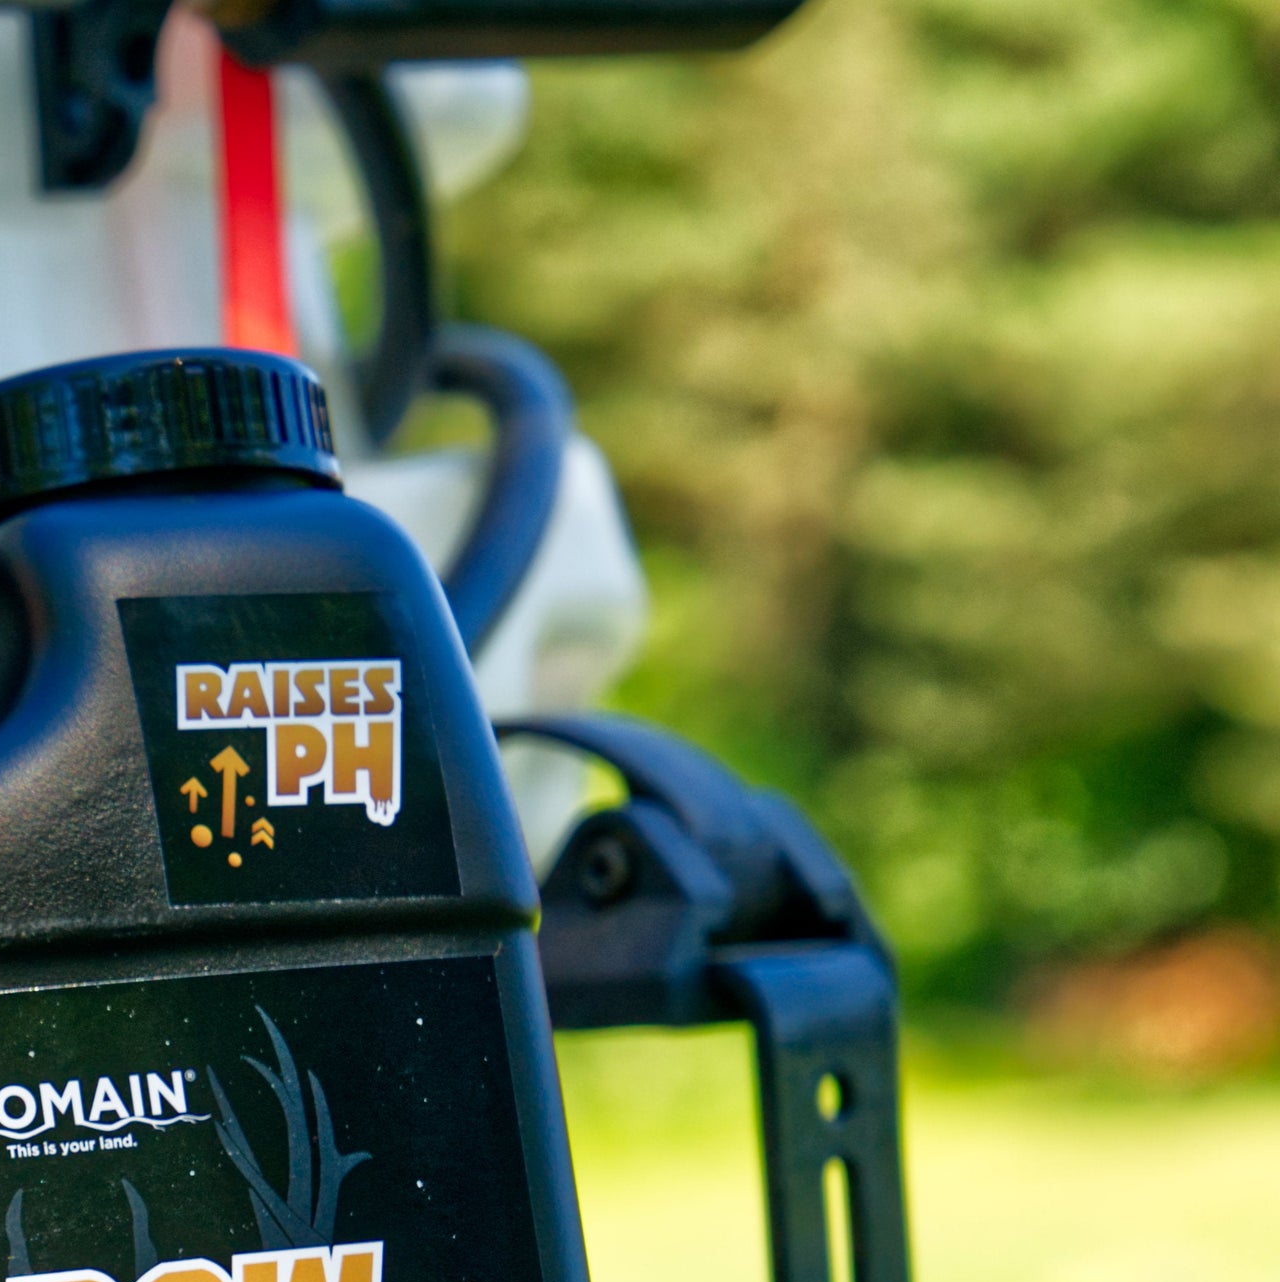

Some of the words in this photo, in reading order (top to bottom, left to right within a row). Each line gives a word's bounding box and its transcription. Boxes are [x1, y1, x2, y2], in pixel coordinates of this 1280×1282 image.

[178, 661, 402, 728] RAISES
[268, 720, 402, 826] PH
[6, 1143, 40, 1159] This
[43, 1141, 57, 1156] is
[60, 1138, 96, 1157] your
[99, 1133, 138, 1151] land.
